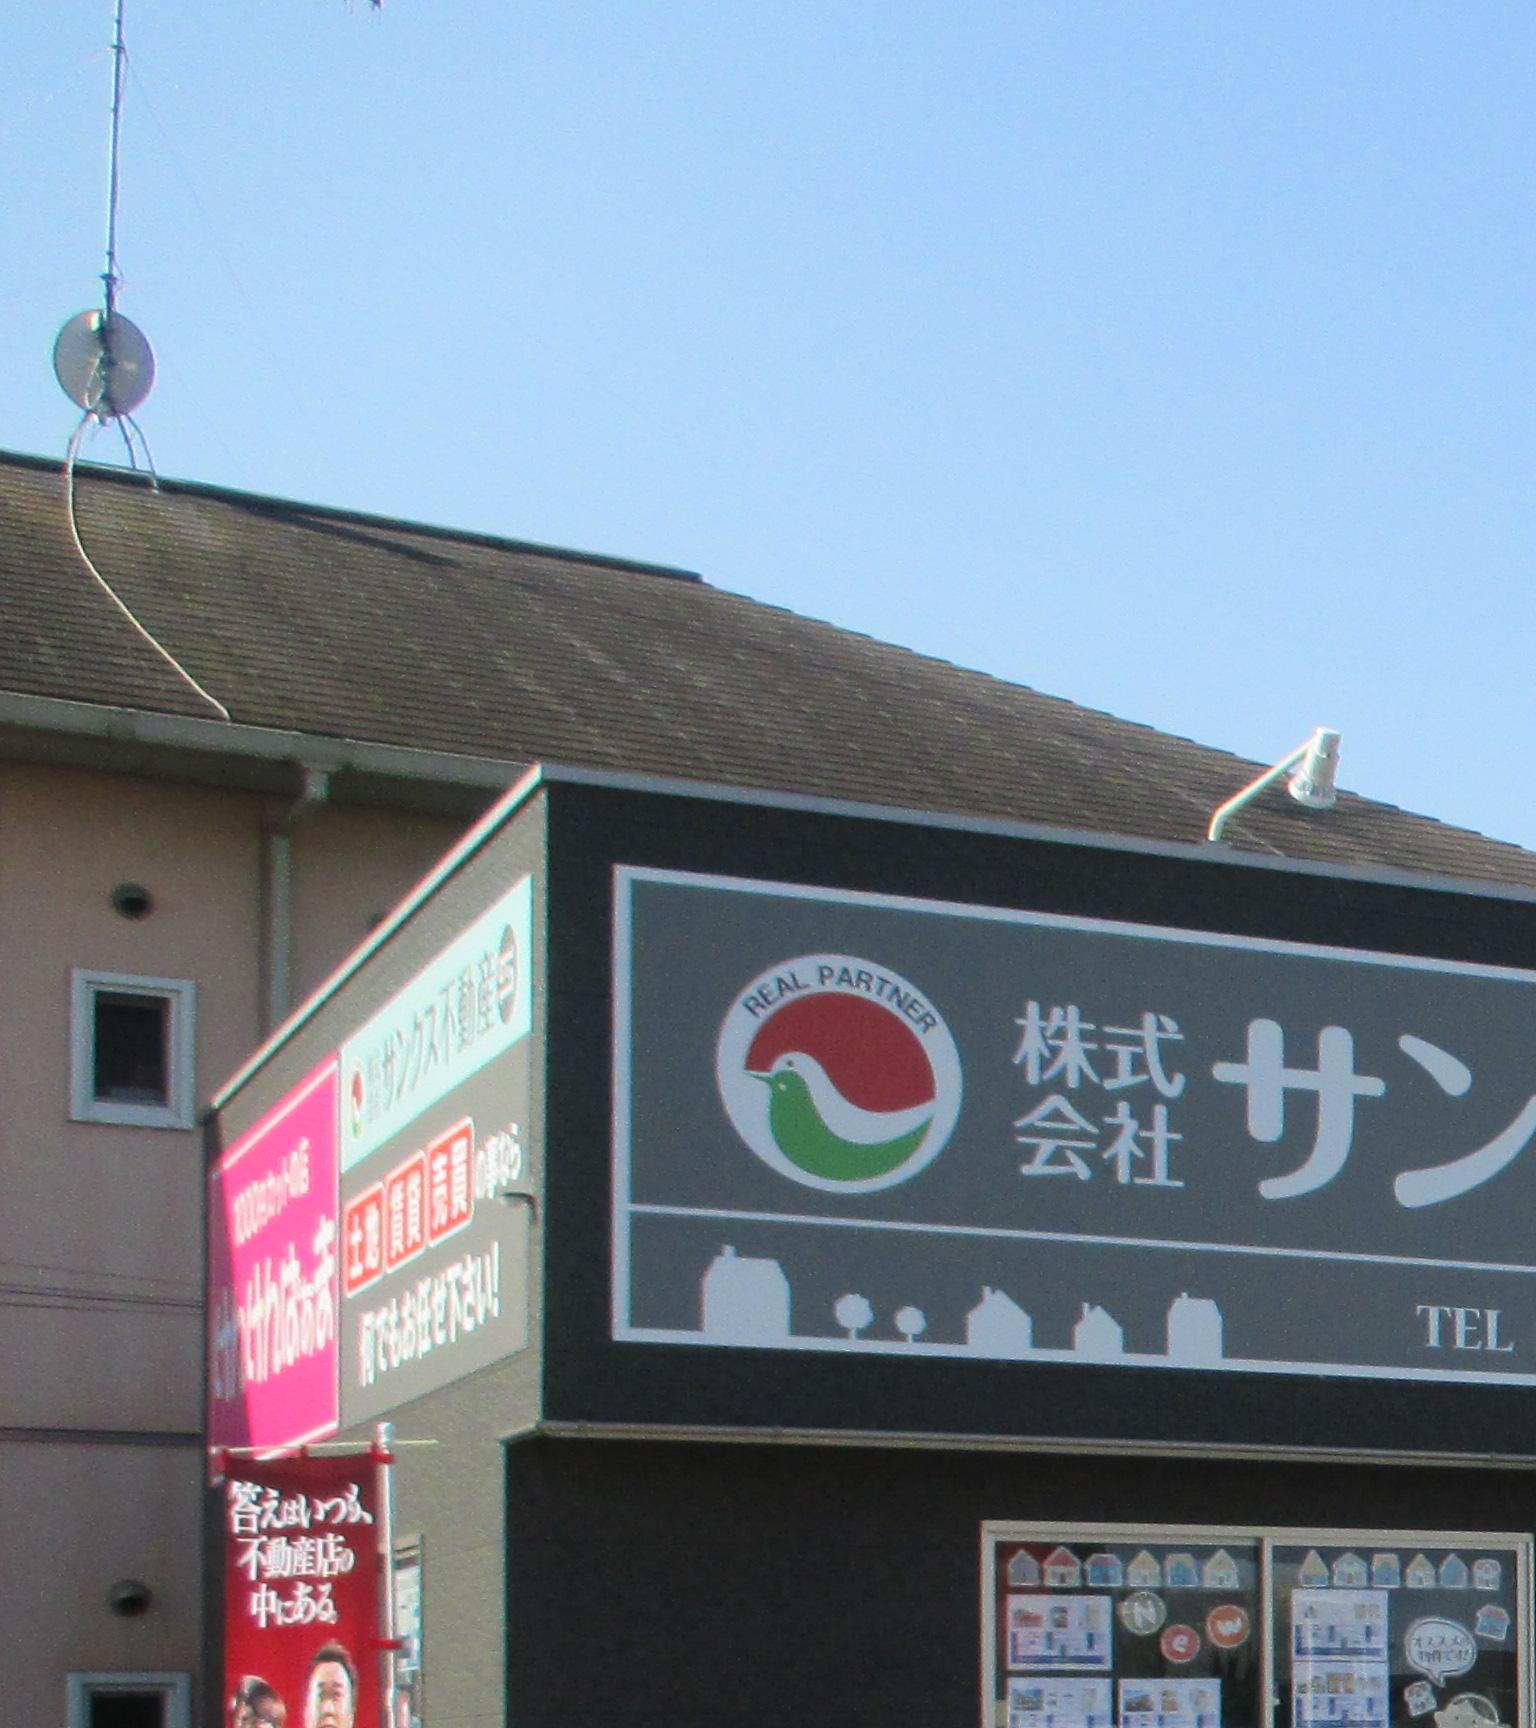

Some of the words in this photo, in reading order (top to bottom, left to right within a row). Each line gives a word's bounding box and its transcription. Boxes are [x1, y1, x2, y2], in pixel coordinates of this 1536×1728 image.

[743, 969, 811, 1019] REAL
[817, 964, 938, 1035] PARTNER
[1012, 1000, 1186, 1098] 株式
[1013, 1094, 1186, 1187] 会社
[1416, 1304, 1515, 1352] TEL
[235, 1532, 355, 1581] 不動産店の
